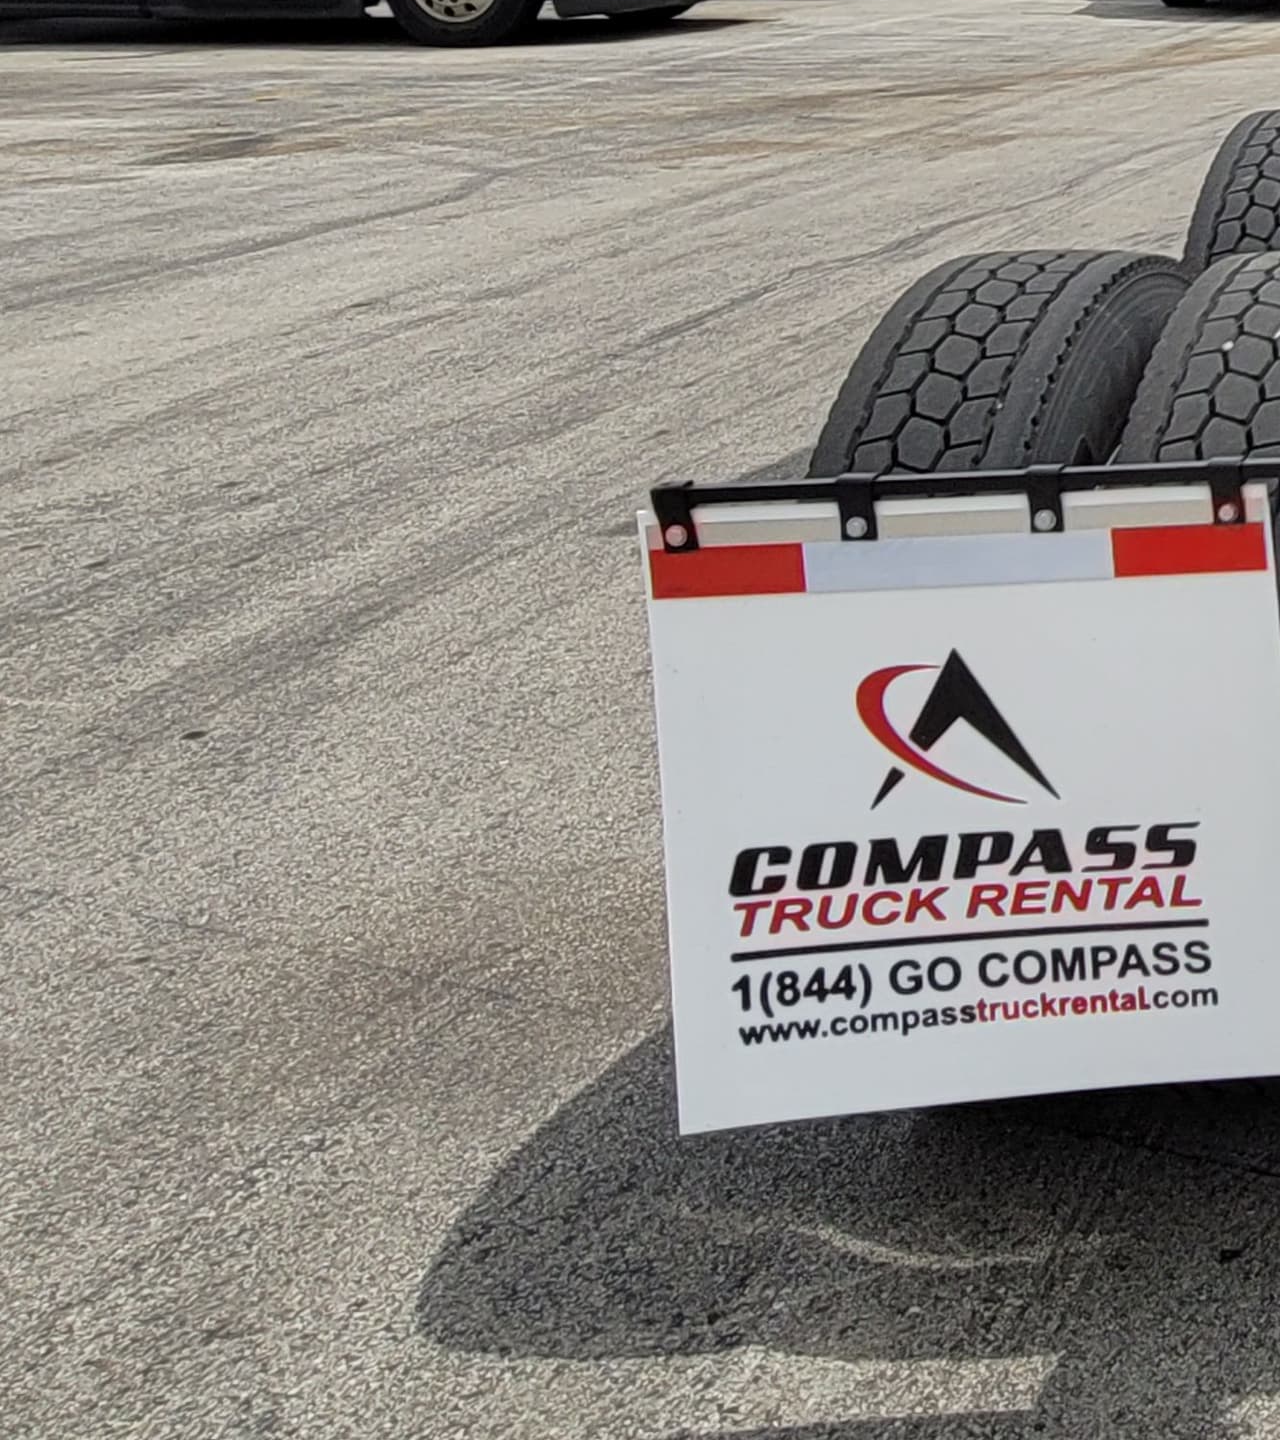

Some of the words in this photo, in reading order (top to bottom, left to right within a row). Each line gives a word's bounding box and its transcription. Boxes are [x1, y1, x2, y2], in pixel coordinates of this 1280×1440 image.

[728, 821, 1201, 898] COMPASS
[732, 885, 951, 938] TRUCK
[965, 874, 1204, 920] RENTAL
[730, 963, 873, 1019] 1(844)
[888, 956, 962, 996] GO
[977, 940, 1213, 988] COMPASS
[738, 983, 1220, 1046] www.compasstruckrental.com
